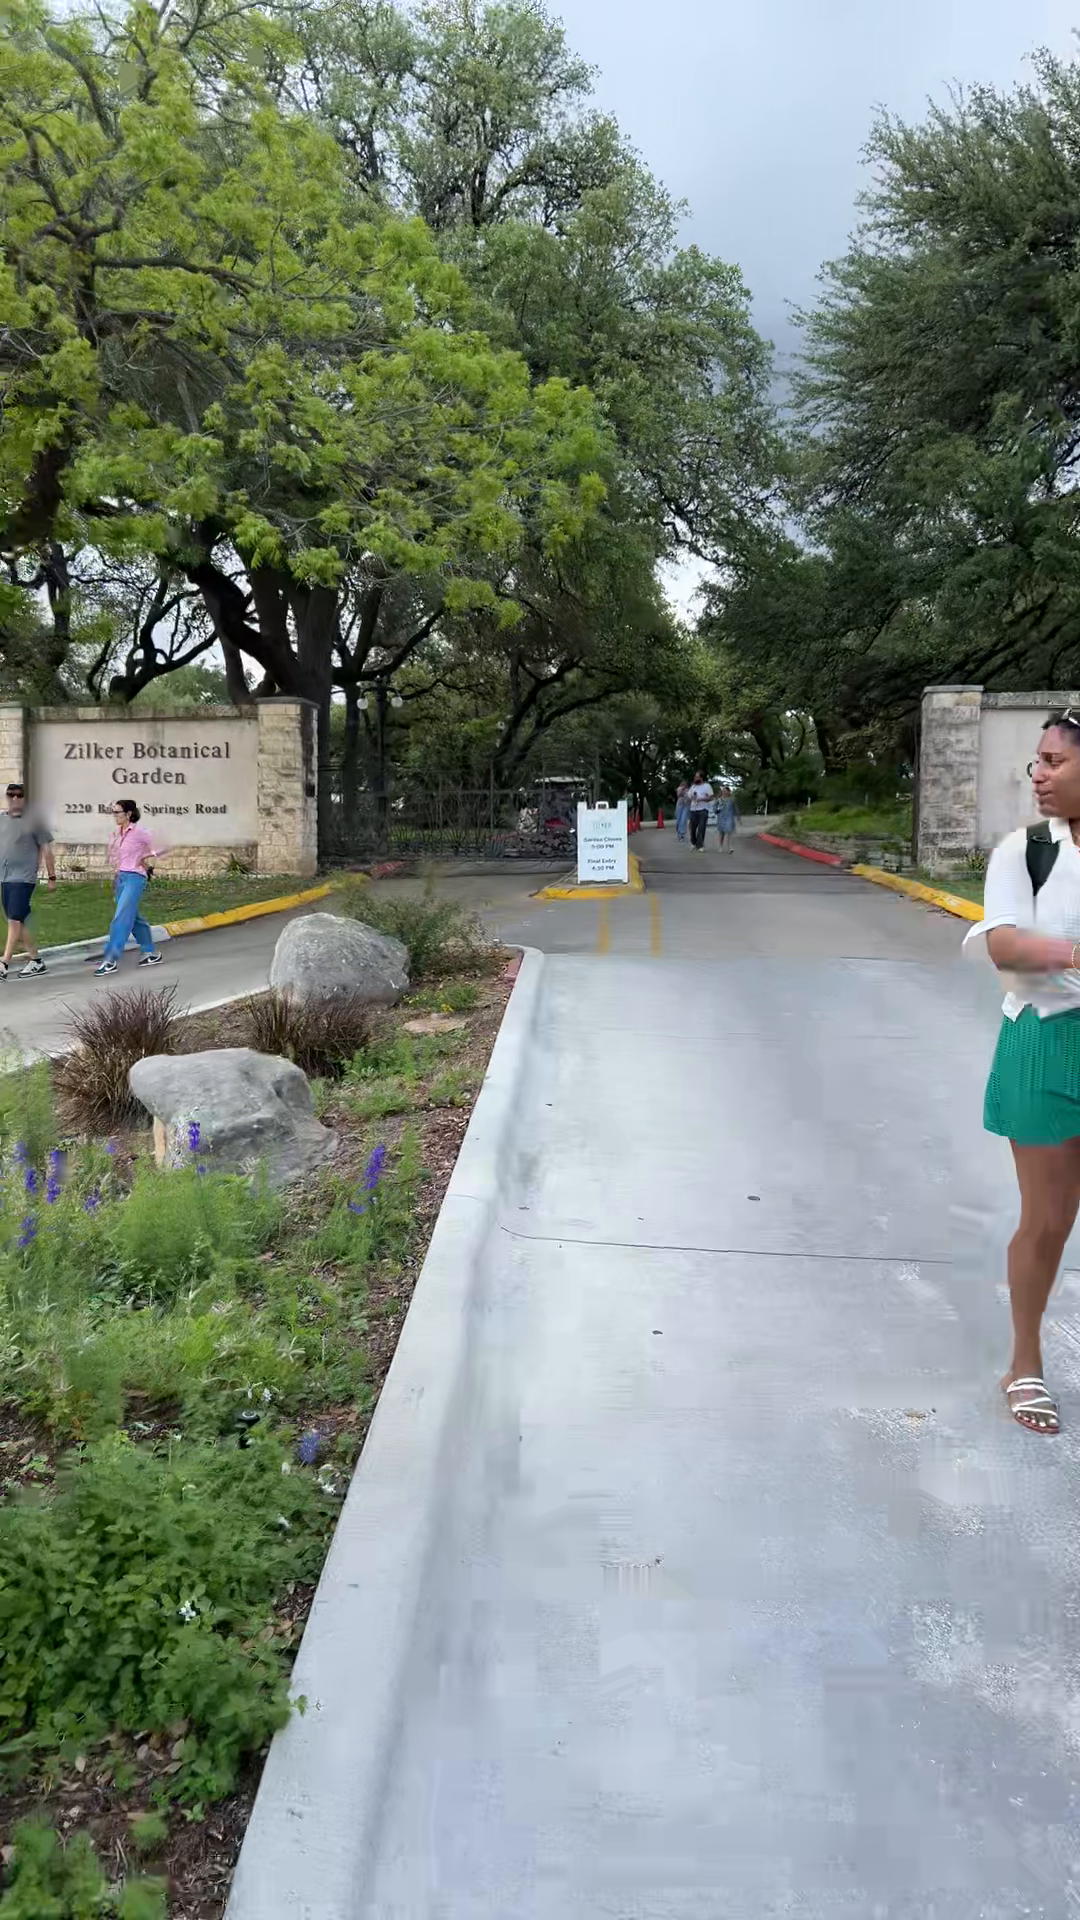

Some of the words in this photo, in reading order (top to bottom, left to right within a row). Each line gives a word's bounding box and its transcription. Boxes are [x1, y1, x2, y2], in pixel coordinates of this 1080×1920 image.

[64, 743, 124, 760] Zilker
[133, 742, 231, 759] Botanical
[112, 767, 187, 785] Garden
[65, 803, 92, 814] 2220
[143, 803, 189, 816] Springs
[195, 803, 227, 814] Road
